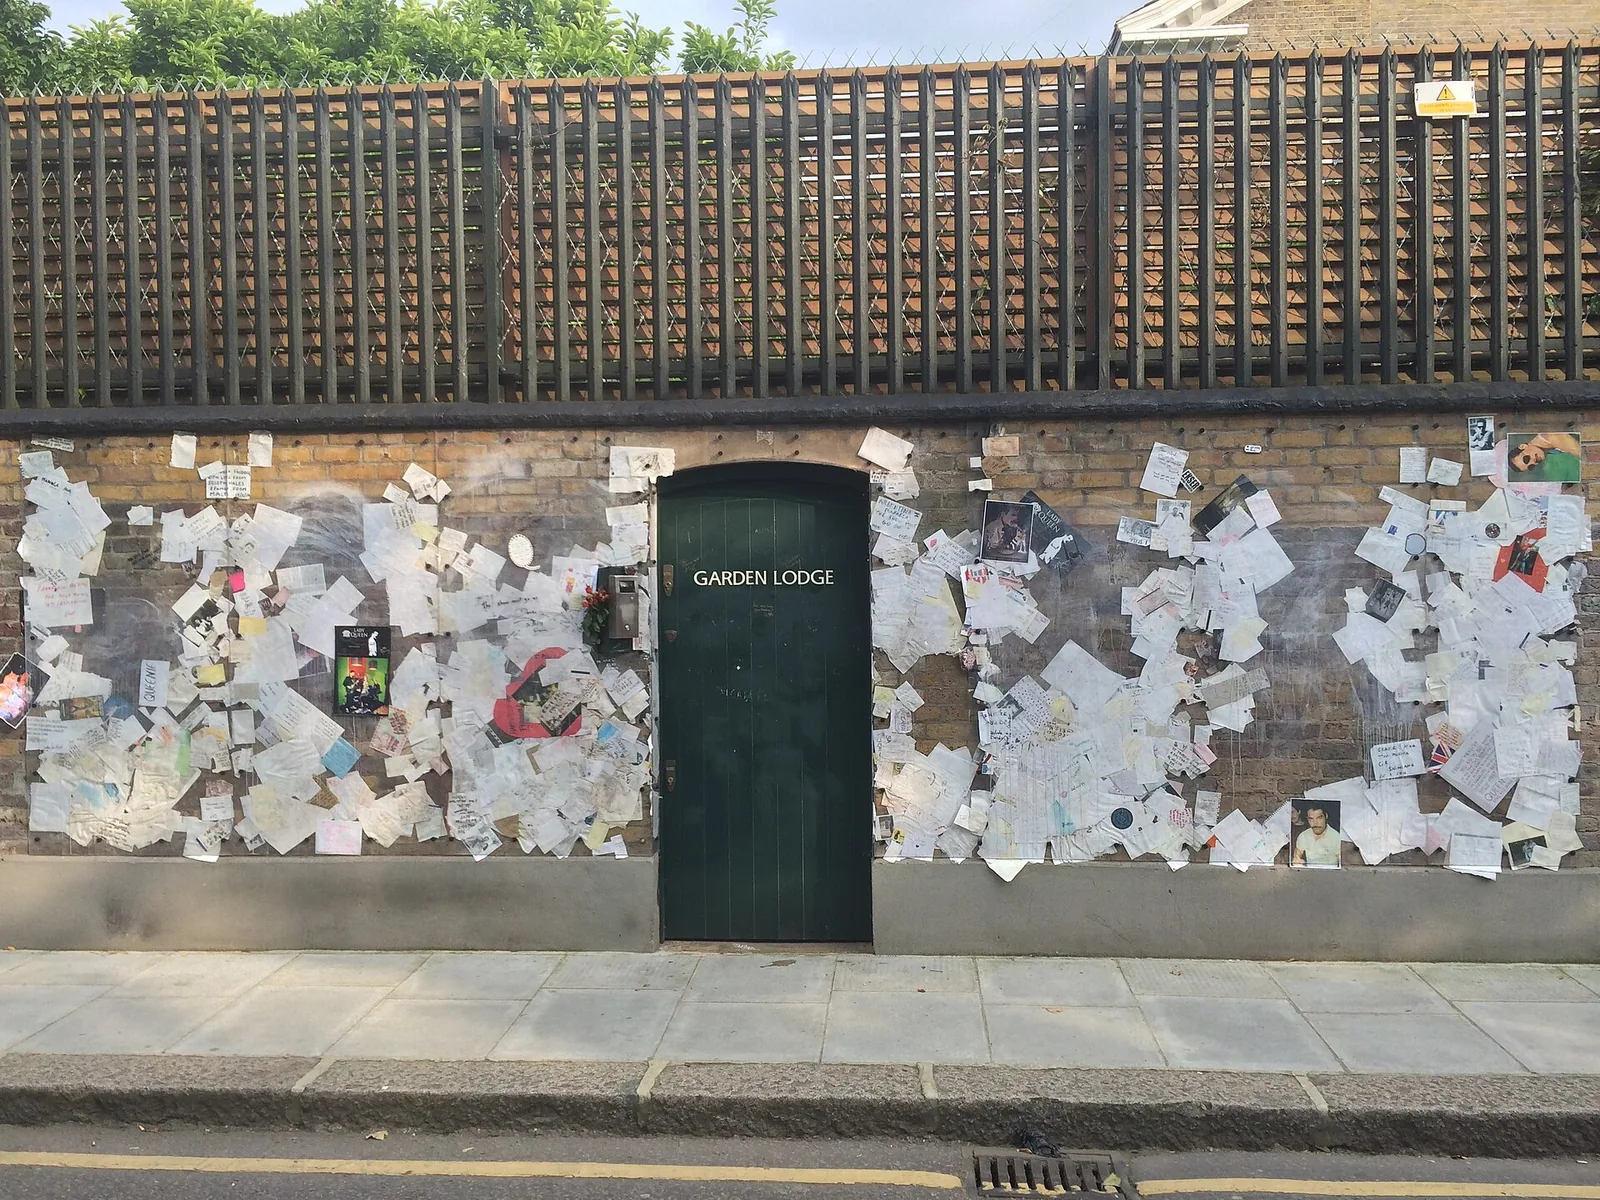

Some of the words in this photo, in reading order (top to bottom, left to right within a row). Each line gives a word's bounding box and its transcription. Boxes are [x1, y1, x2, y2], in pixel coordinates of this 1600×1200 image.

[1038, 511, 1060, 533] QUEEN
[1046, 509, 1061, 525] LADY
[693, 570, 767, 586] GARDEN
[773, 569, 834, 585] LODGE
